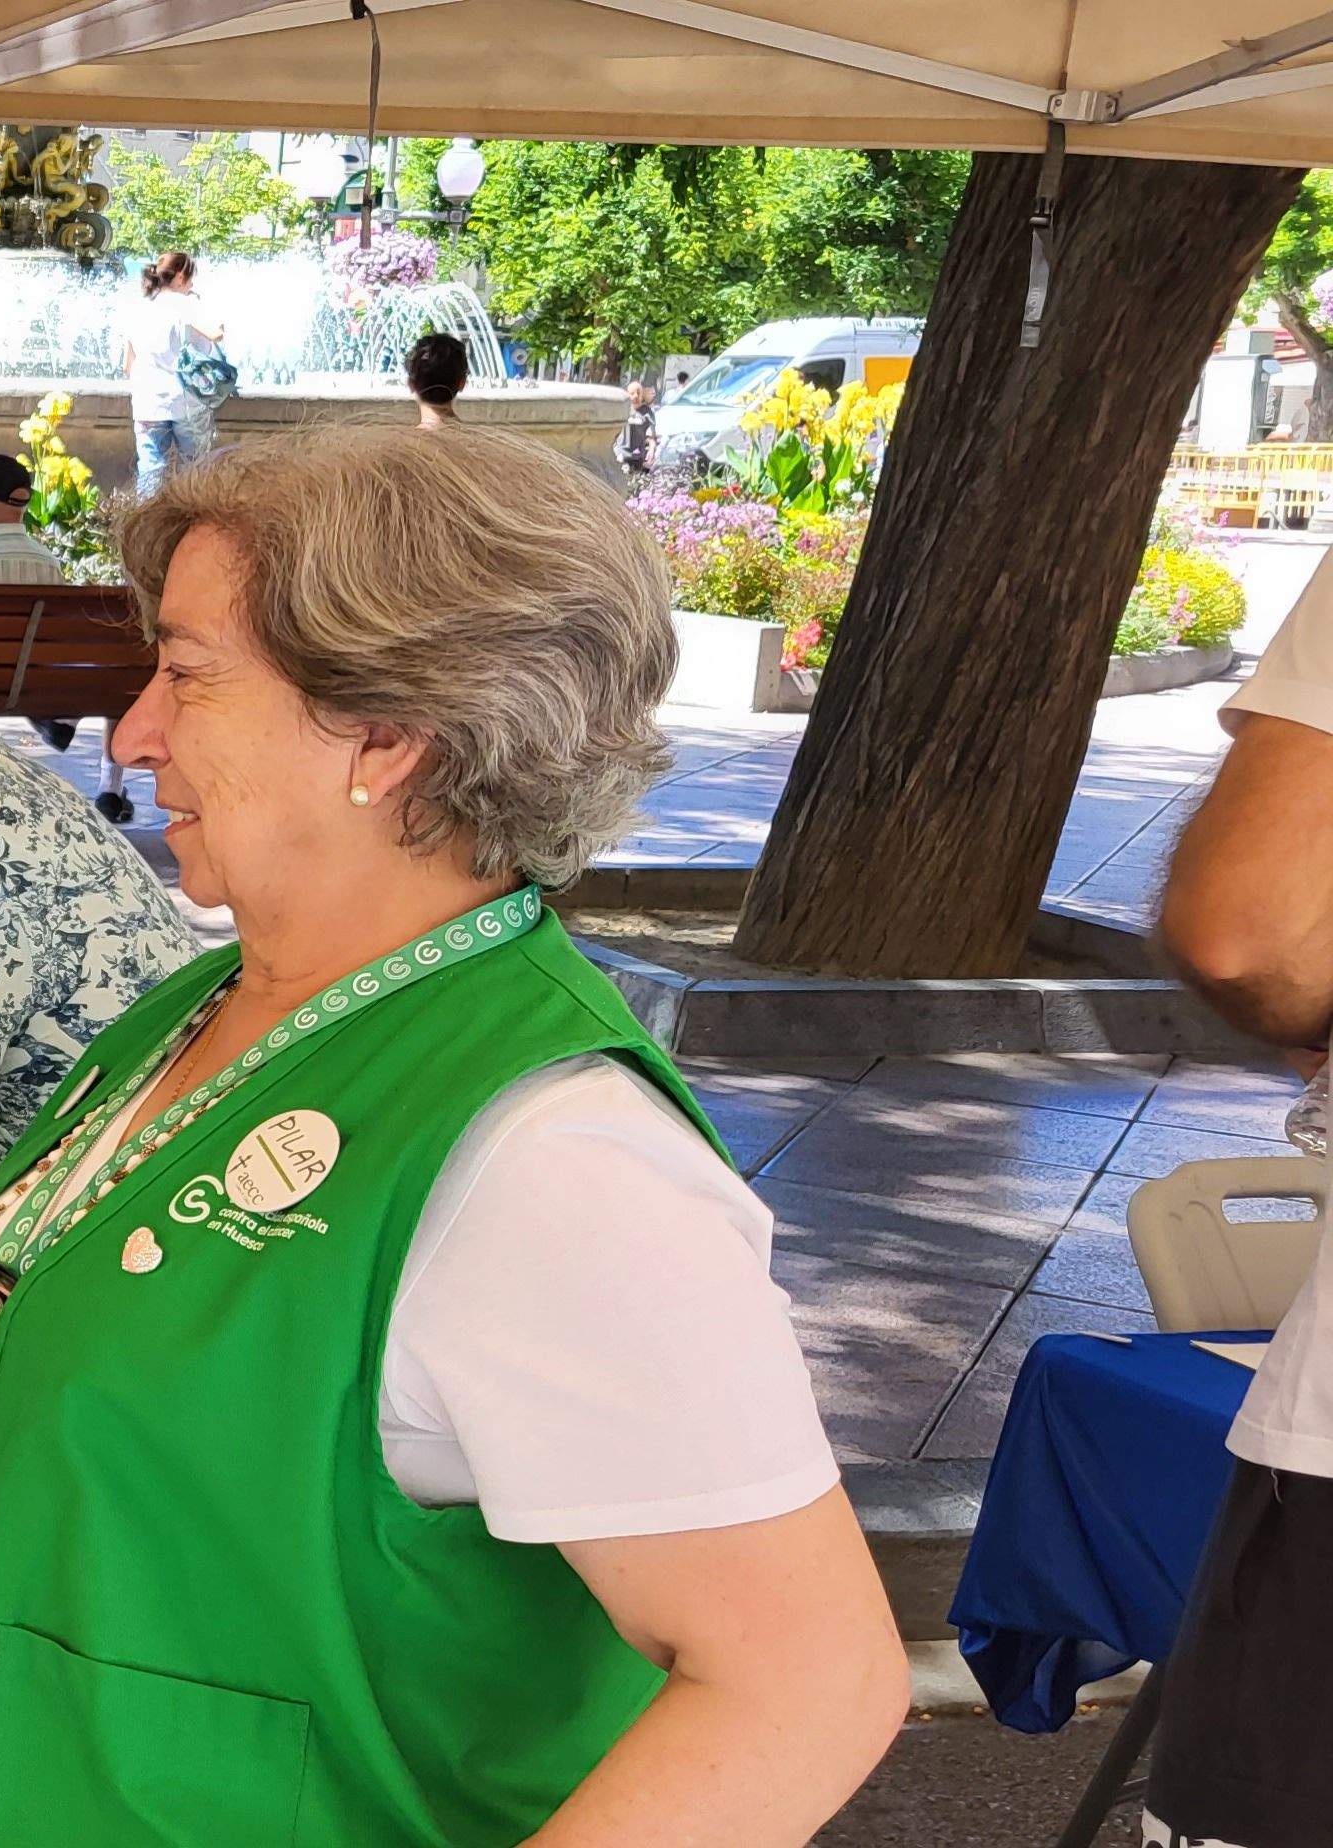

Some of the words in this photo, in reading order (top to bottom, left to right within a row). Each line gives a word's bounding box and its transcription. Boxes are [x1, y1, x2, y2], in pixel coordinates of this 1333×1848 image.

[267, 1115, 327, 1184] PILAR
[237, 1171, 265, 1206] aecc
[206, 1219, 222, 1231] en
[218, 1208, 258, 1232] contra
